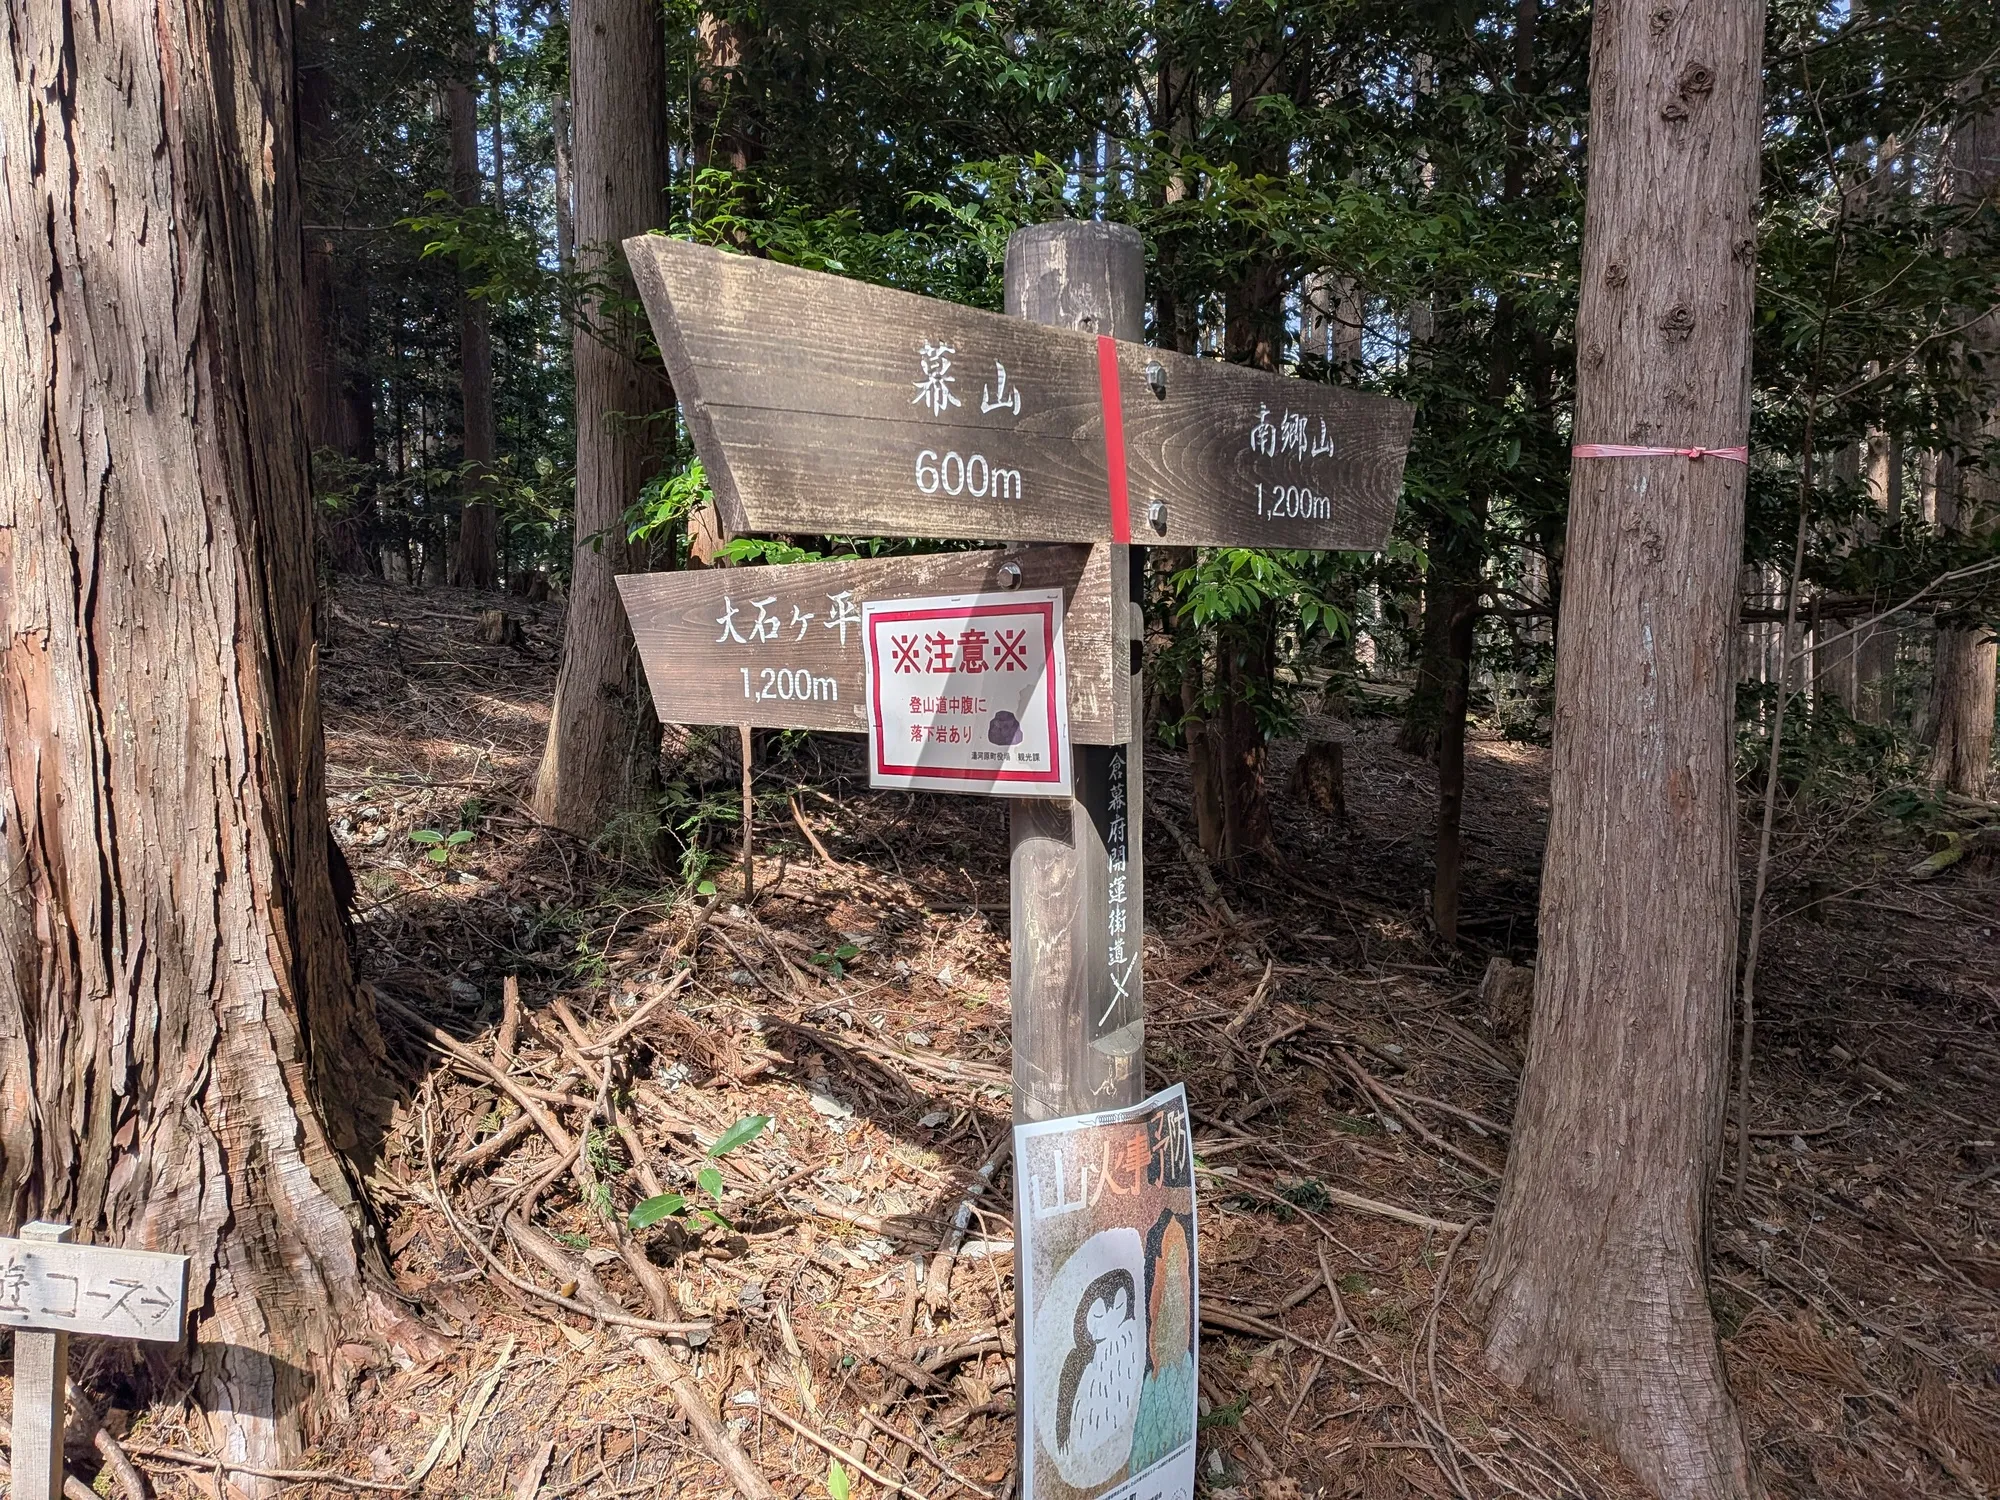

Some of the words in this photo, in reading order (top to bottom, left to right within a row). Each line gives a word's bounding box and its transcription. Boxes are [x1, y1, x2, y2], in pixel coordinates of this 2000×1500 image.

[911, 339, 1022, 418] 幕山
[1250, 401, 1334, 463] 南郷山
[915, 450, 1021, 499] 600m
[1255, 482, 1331, 521] 1,200m
[739, 666, 838, 703] 1,200m
[909, 696, 987, 715] 登山道中腹に
[910, 724, 973, 744] 落下岩あり
[1107, 745, 1128, 966] 倉幕府開運街道
[1031, 1109, 1186, 1220] 山火事予防
